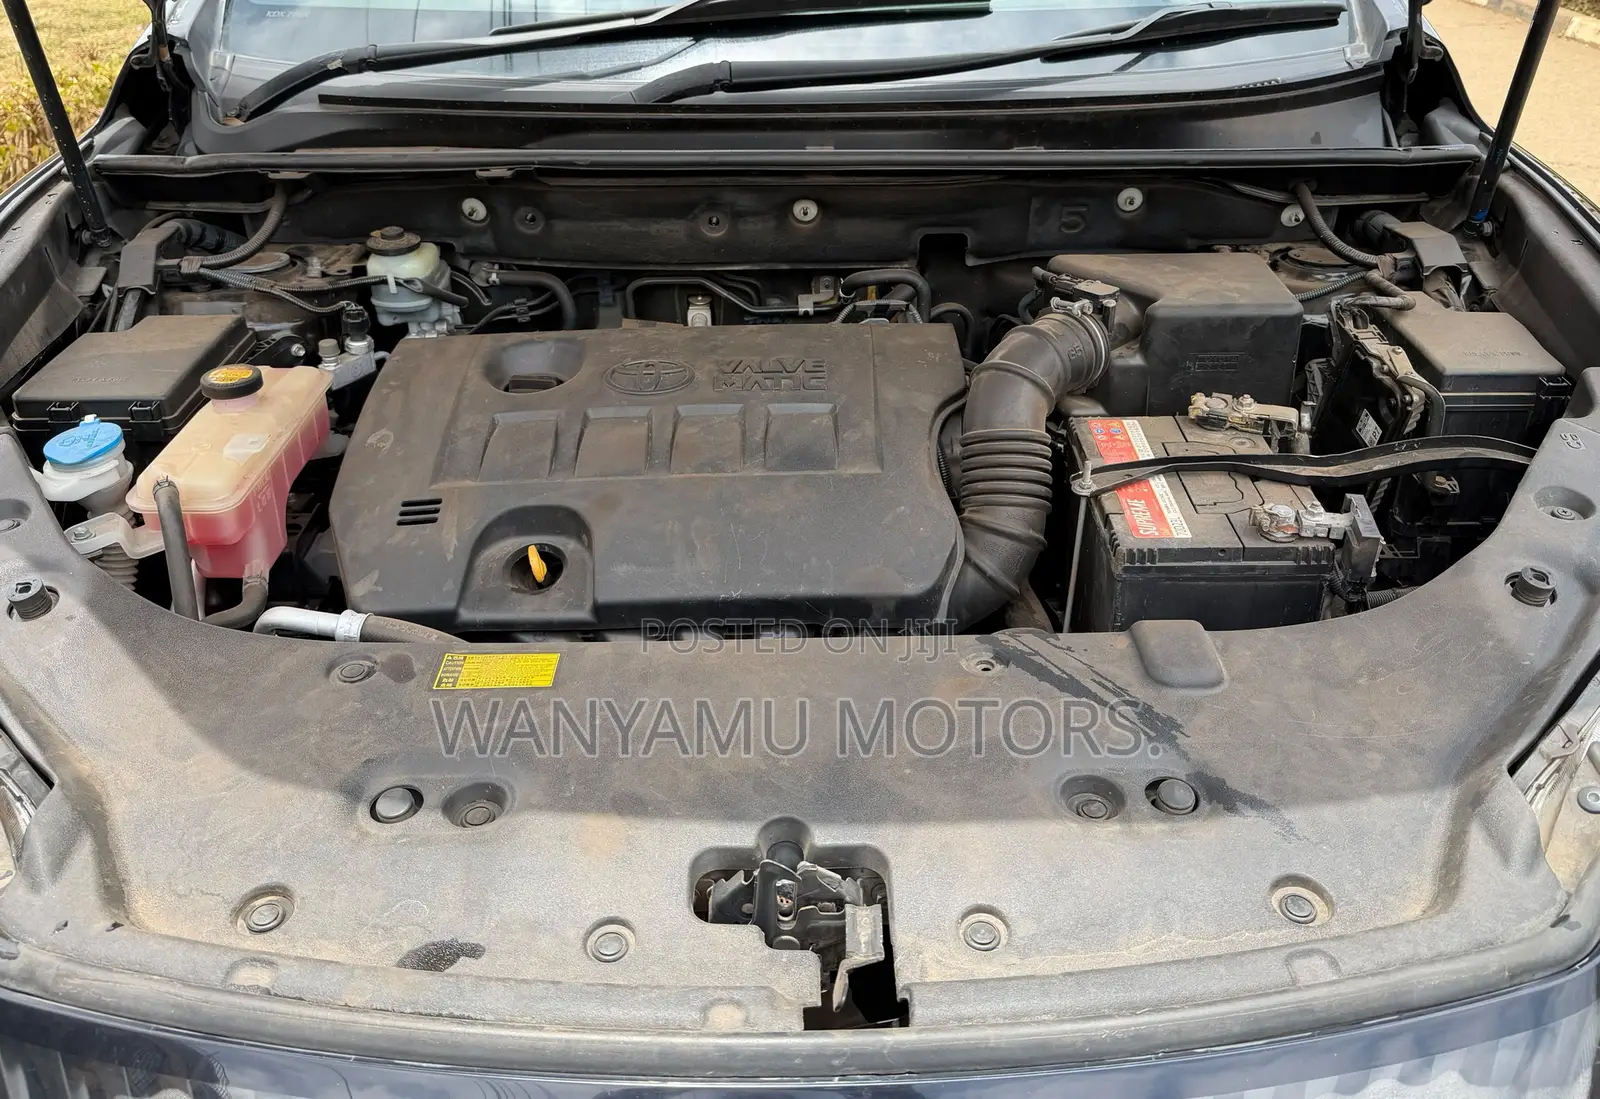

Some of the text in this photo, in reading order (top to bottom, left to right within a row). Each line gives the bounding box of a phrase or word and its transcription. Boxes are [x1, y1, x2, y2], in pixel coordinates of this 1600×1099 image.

[1060, 205, 1088, 234] 5
[716, 358, 827, 374] VALVE
[712, 376, 828, 392] MATIC
[1128, 499, 1159, 536] SUPREME
